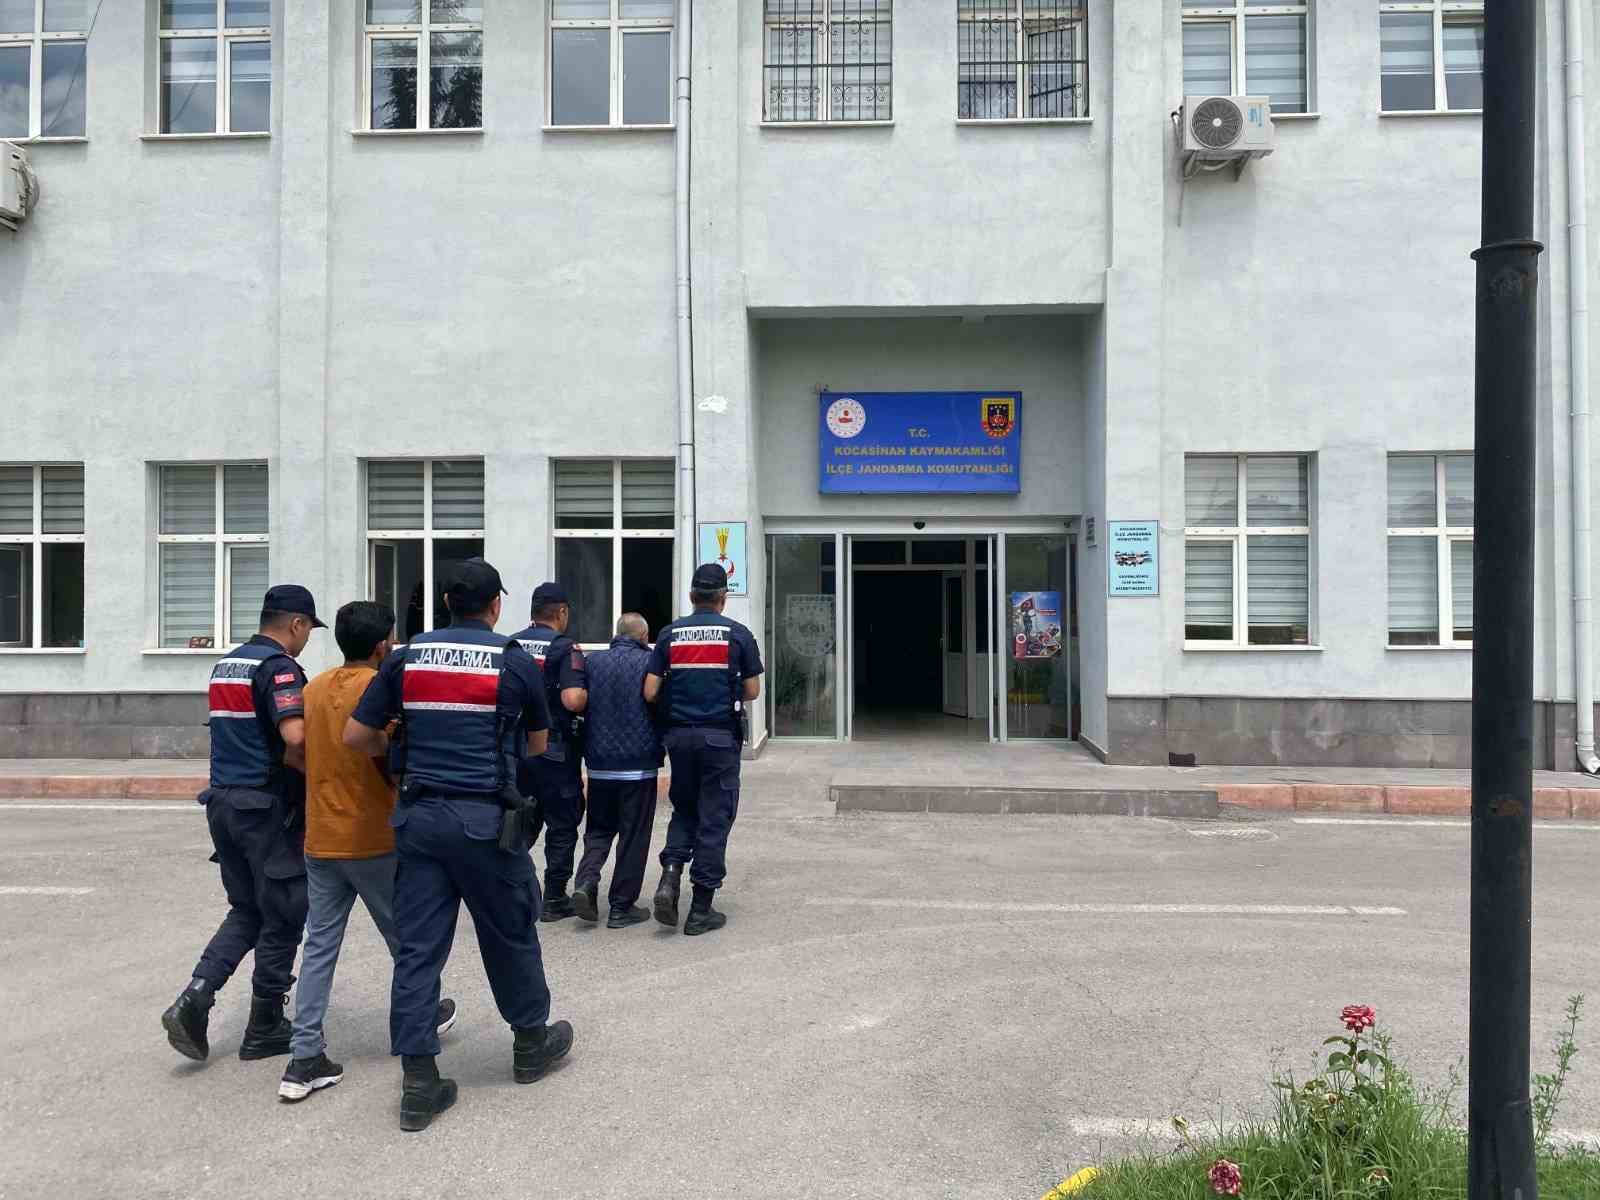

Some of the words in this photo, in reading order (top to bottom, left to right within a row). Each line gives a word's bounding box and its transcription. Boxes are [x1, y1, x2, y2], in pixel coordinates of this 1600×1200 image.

[908, 428, 931, 438] T.C.
[834, 445, 906, 457] KOCASİNAN
[910, 446, 1005, 457] KAYMAKAMLIĞI
[826, 463, 852, 476] İLÇE
[857, 464, 924, 475] JANDARMA
[927, 463, 1014, 474] KOMUTANLIĞI
[674, 629, 724, 641] JANDARMA
[414, 647, 493, 670] JANDARMA
